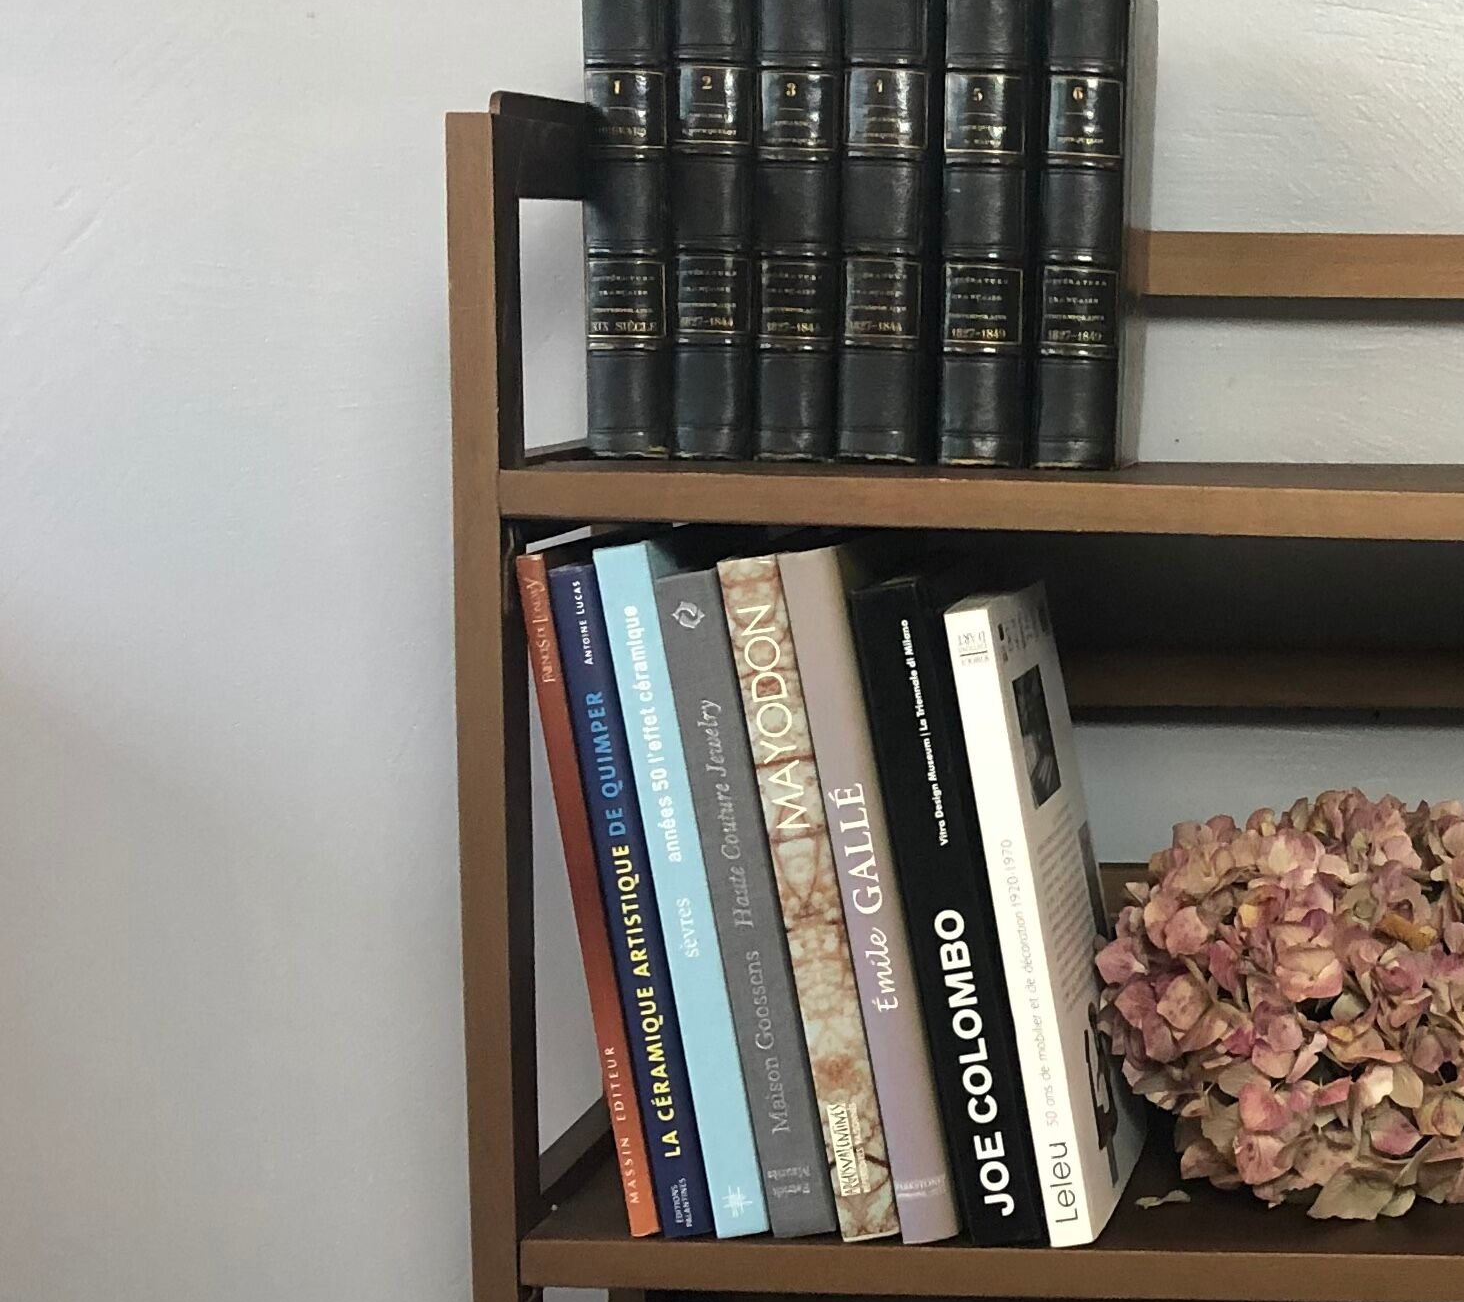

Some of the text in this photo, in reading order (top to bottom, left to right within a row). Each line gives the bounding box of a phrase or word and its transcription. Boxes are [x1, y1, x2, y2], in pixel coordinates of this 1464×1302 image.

[701, 75, 713, 90] 2
[786, 82, 797, 97] 3
[972, 88, 983, 101] 5
[1073, 87, 1084, 100] 6
[697, 699, 727, 778] Jewelry
[737, 604, 811, 830] MAYODON
[900, 619, 949, 846] Vitra Design Museum La Triennale di Milano
[624, 605, 700, 958] sèvres années 50 l'effet céramique
[715, 782, 741, 861] Couture
[586, 691, 681, 1157] LA CÉRAMIQUE ARTISTIQUE DE QUIMPER
[728, 866, 754, 929] Haute
[828, 783, 899, 1013] Émile GALLÉ
[1015, 911, 1034, 973] décoration
[746, 950, 775, 1051] Goossens
[1025, 978, 1037, 993] de
[1030, 998, 1040, 1009] et
[934, 909, 1015, 1217] JOE COLOMBO
[1032, 1014, 1048, 1061] mobilier
[1040, 1066, 1052, 1081] de
[605, 1046, 640, 1204] MASSIN EDITEUR
[765, 1056, 791, 1135] Maison
[1044, 1085, 1056, 1106] ans
[1049, 1142, 1079, 1223] Leleu
